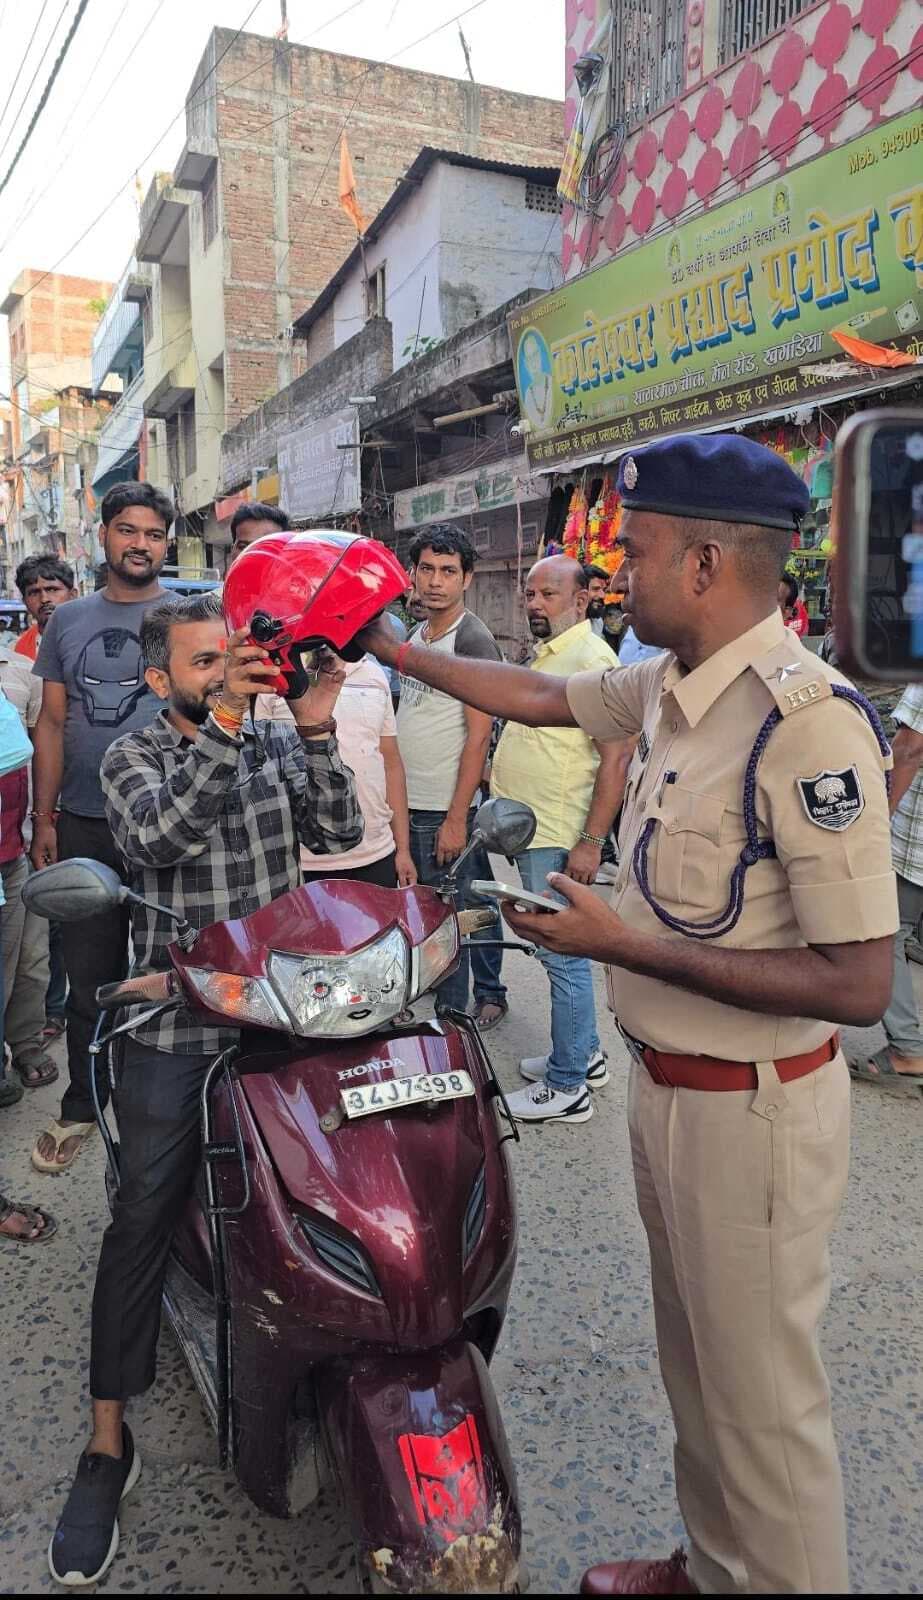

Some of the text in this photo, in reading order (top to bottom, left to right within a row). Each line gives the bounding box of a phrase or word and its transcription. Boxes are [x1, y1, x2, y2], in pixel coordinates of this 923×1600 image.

[848, 146, 879, 175] Mob.
[719, 236, 751, 261] आपकी
[753, 228, 777, 246] सेवा
[778, 215, 791, 235] में
[551, 304, 658, 396] कालेश्वर
[661, 262, 757, 364] प्रसाद
[762, 208, 881, 329] प्रमोद
[733, 352, 760, 376] रोड,
[763, 331, 824, 366] खगड़िया
[716, 390, 734, 410] खेल
[755, 379, 769, 404] एवं
[772, 375, 798, 397] जीवन
[337, 1057, 406, 1081] HONDA
